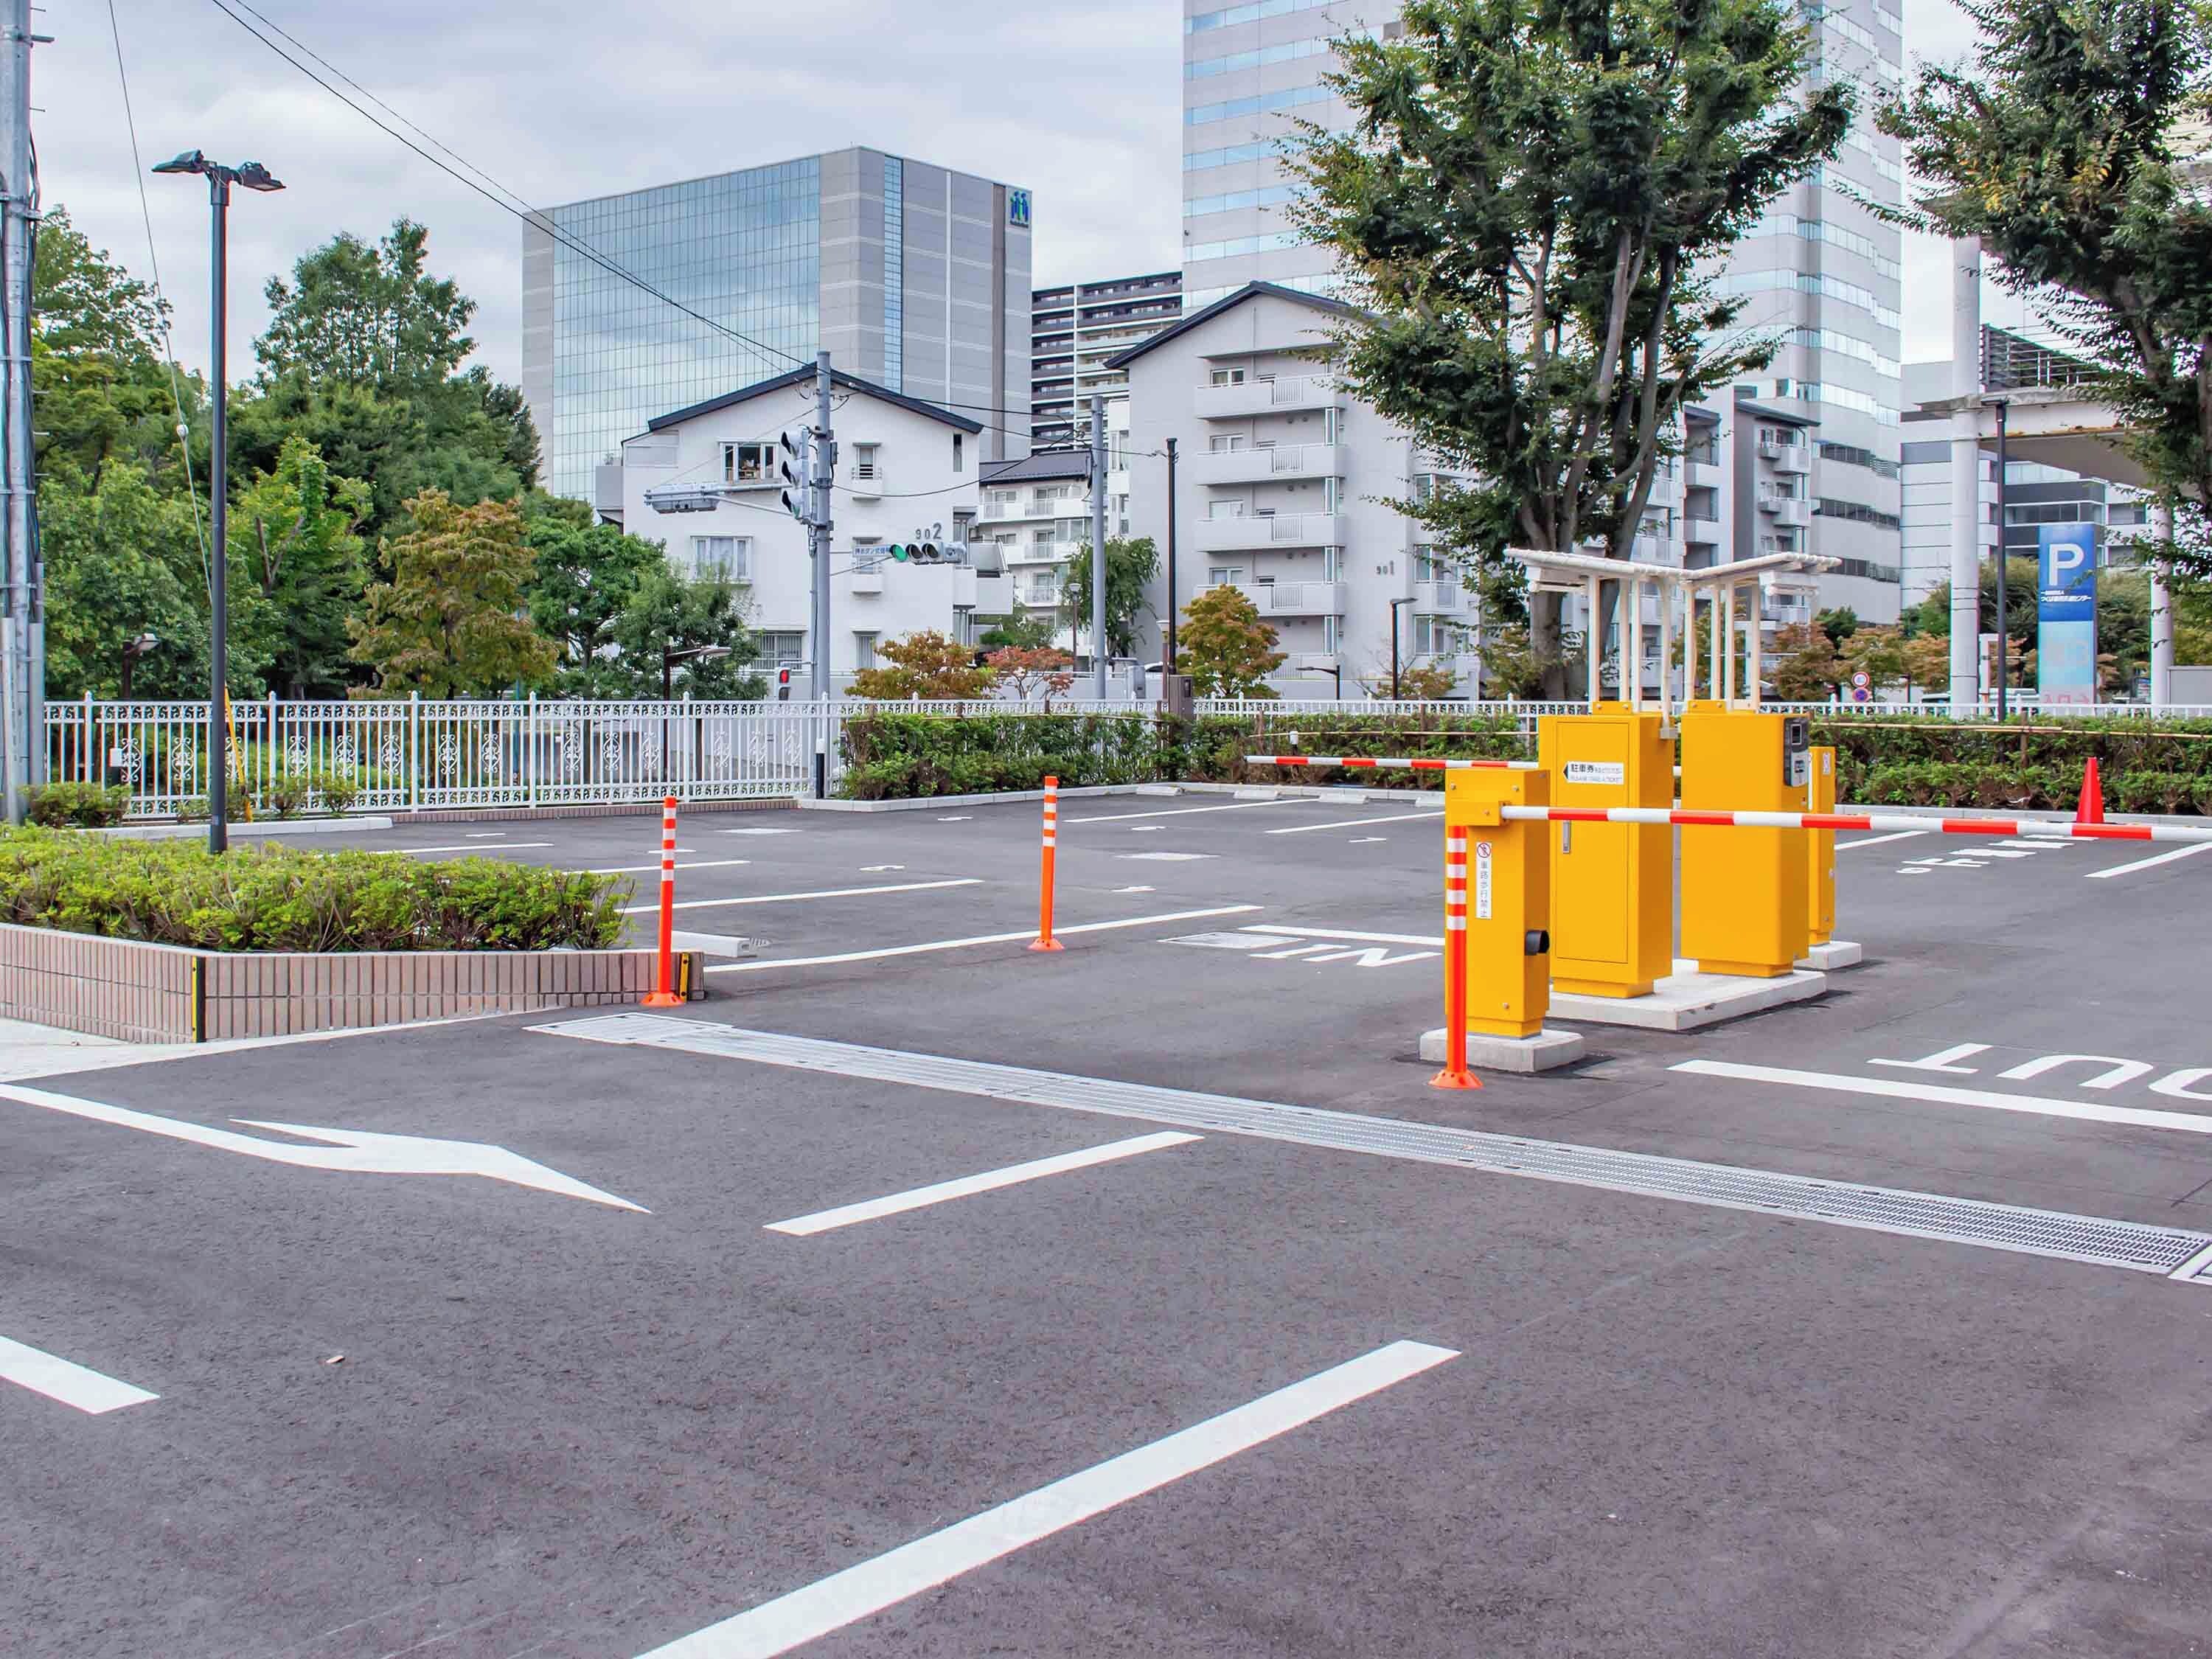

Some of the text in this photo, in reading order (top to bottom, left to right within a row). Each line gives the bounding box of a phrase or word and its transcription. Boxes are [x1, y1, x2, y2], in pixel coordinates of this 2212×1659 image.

[915, 522, 942, 540] 902
[2048, 543, 2084, 586] P
[1246, 943, 1444, 967] IN
